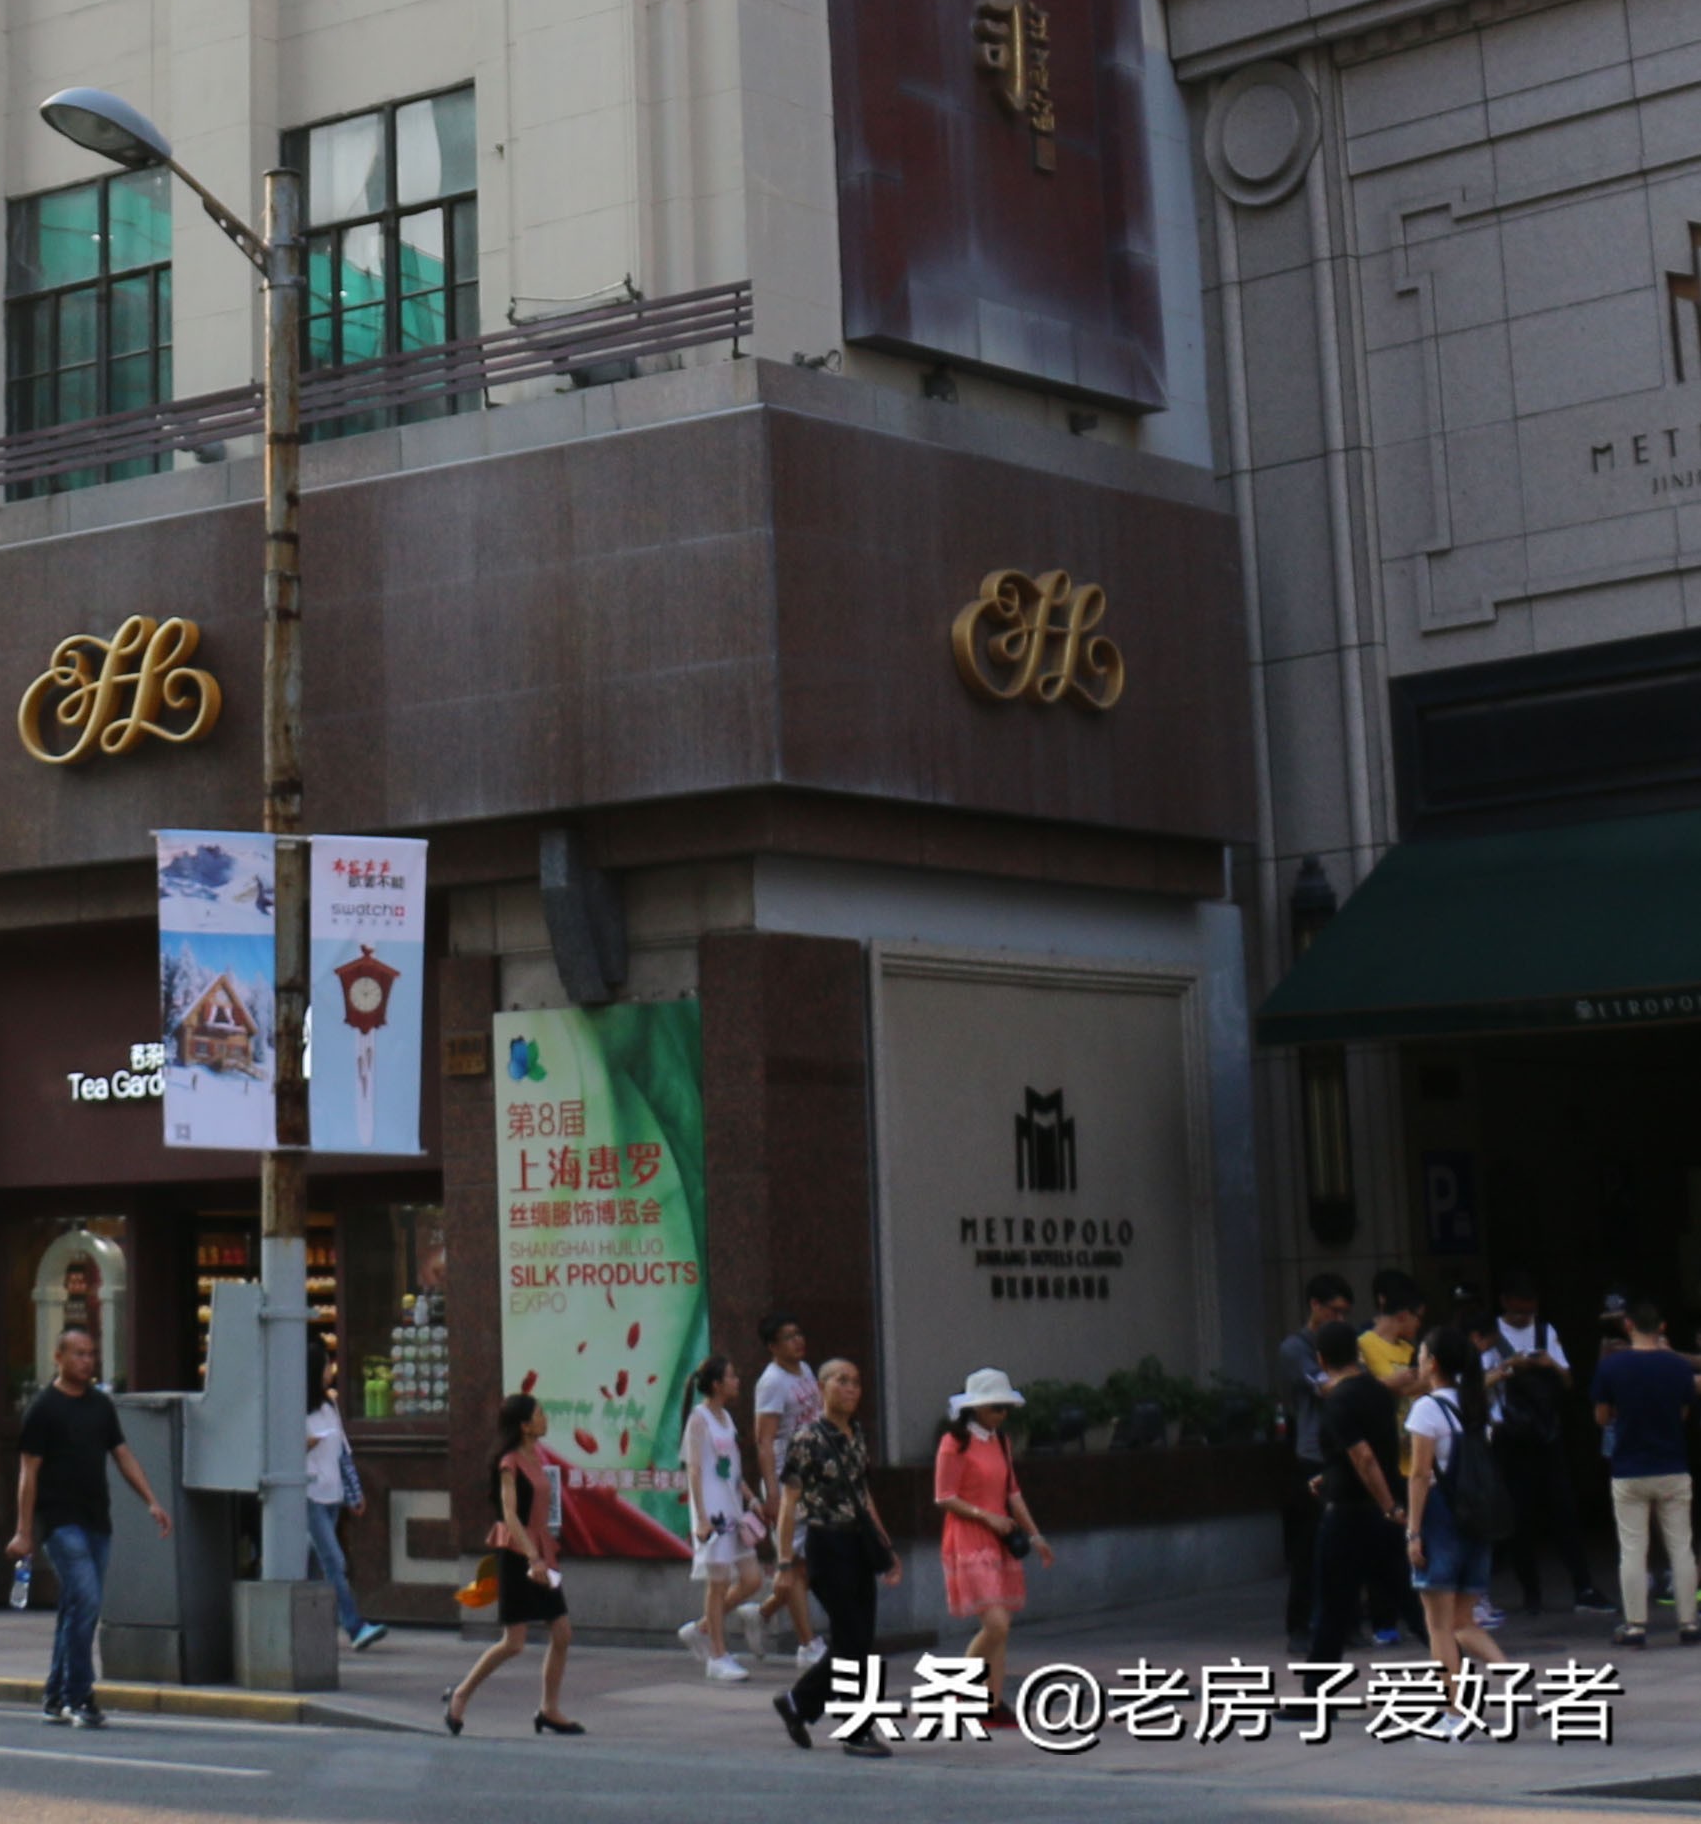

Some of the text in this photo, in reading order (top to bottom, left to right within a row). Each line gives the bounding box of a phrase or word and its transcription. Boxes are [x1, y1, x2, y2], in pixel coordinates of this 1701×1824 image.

[1590, 423, 1701, 474] MET
[331, 902, 395, 917] swatch
[67, 1072, 109, 1101] Tea
[507, 1100, 587, 1140] 第8届
[509, 1142, 663, 1193] 上海惠罗
[509, 1197, 663, 1229] 丝绸服饰博览会
[959, 1216, 1135, 1247] METROPOLO
[509, 1237, 664, 1259] SHANGHAI HUILUO
[510, 1261, 700, 1288] SILK PRODUCTS
[509, 1292, 567, 1315] EXPO
